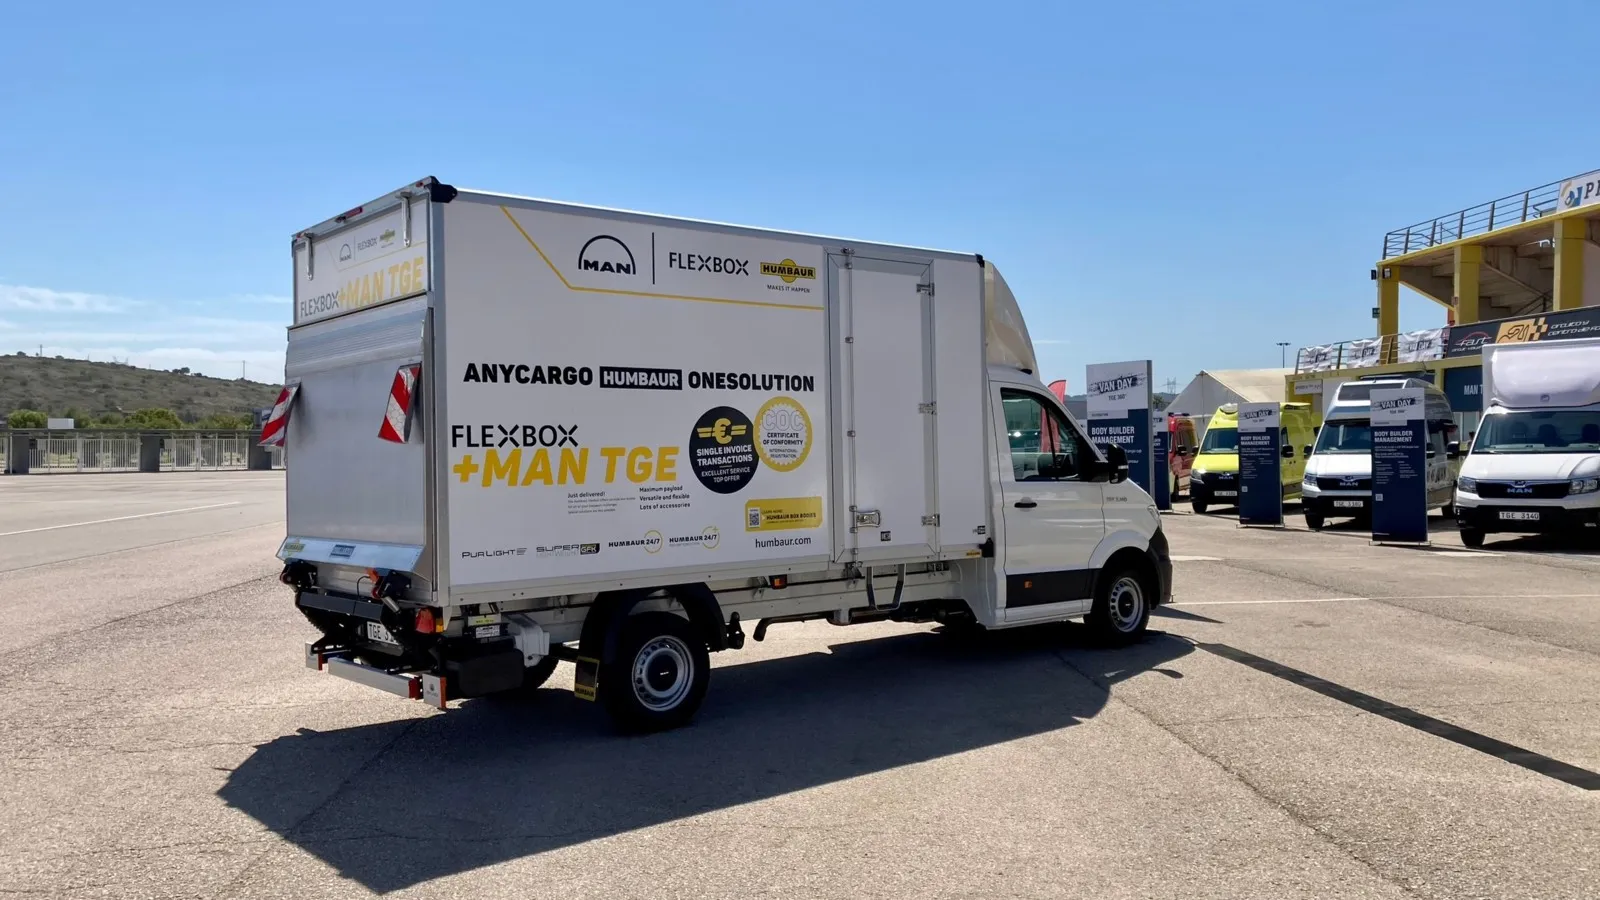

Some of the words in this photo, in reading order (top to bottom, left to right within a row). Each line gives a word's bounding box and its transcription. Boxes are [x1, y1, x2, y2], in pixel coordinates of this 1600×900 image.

[583, 259, 632, 274] MAN
[669, 252, 749, 276] FLEXBOX
[388, 256, 424, 297] TGE
[763, 265, 814, 278] HUMBAUR
[463, 362, 593, 386] ANYCARGO
[603, 370, 680, 387] HUMBAUR
[688, 371, 814, 392] ONESOLUTION
[1098, 382, 1116, 393] VAN
[1117, 378, 1133, 390] DAY
[1464, 384, 1478, 395] MAN
[1382, 401, 1396, 409] VAN
[762, 410, 804, 431] COC
[452, 424, 578, 448] FLEXBOX
[1091, 427, 1107, 435] BODY
[1109, 426, 1135, 434] BUILDER
[1091, 436, 1134, 444] MANAGEMENT
[696, 447, 723, 457] SINGLE
[724, 444, 752, 454] INVOICE
[600, 447, 680, 484] TGE
[697, 454, 753, 466] TRANSACTIONS
[702, 469, 729, 477] EXCELLENT
[664, 485, 683, 493] payload
[536, 544, 580, 553] SUPER
[755, 537, 812, 548] humbaur.com
[369, 624, 381, 640] TGE
